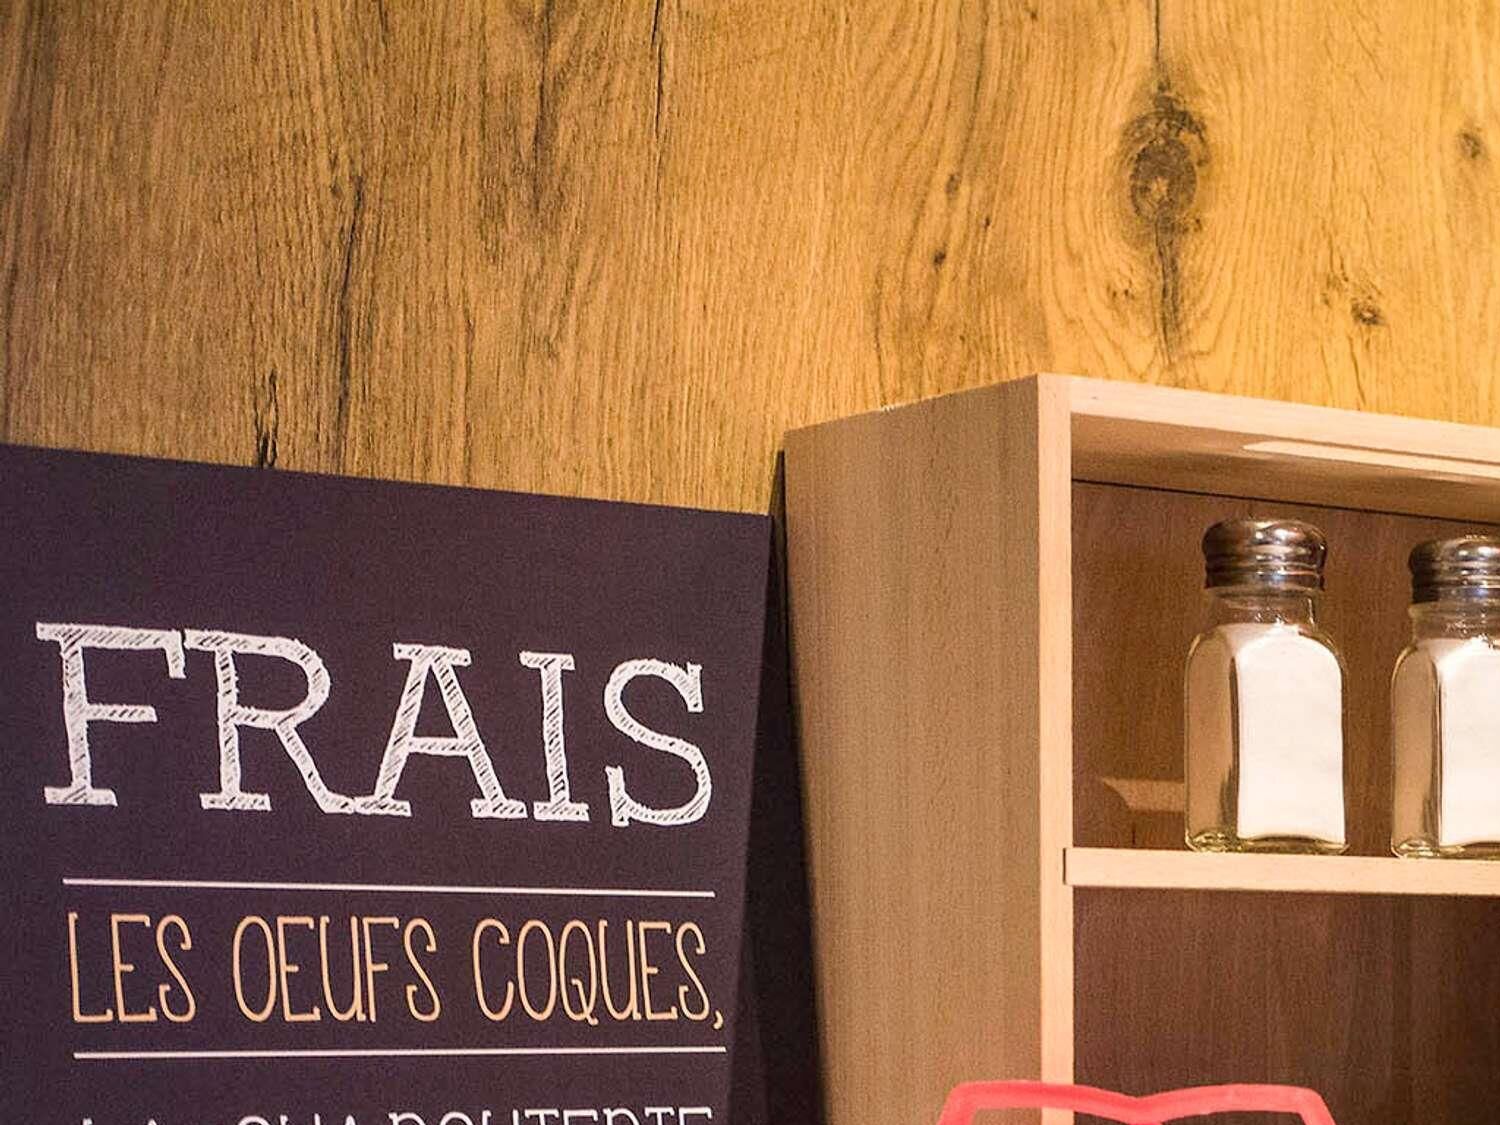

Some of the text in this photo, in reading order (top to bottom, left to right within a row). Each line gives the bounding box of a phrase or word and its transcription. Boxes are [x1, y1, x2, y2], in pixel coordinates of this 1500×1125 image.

[36, 622, 712, 827] FRAIS
[68, 912, 723, 1029] LES OEUFS COQUES,
